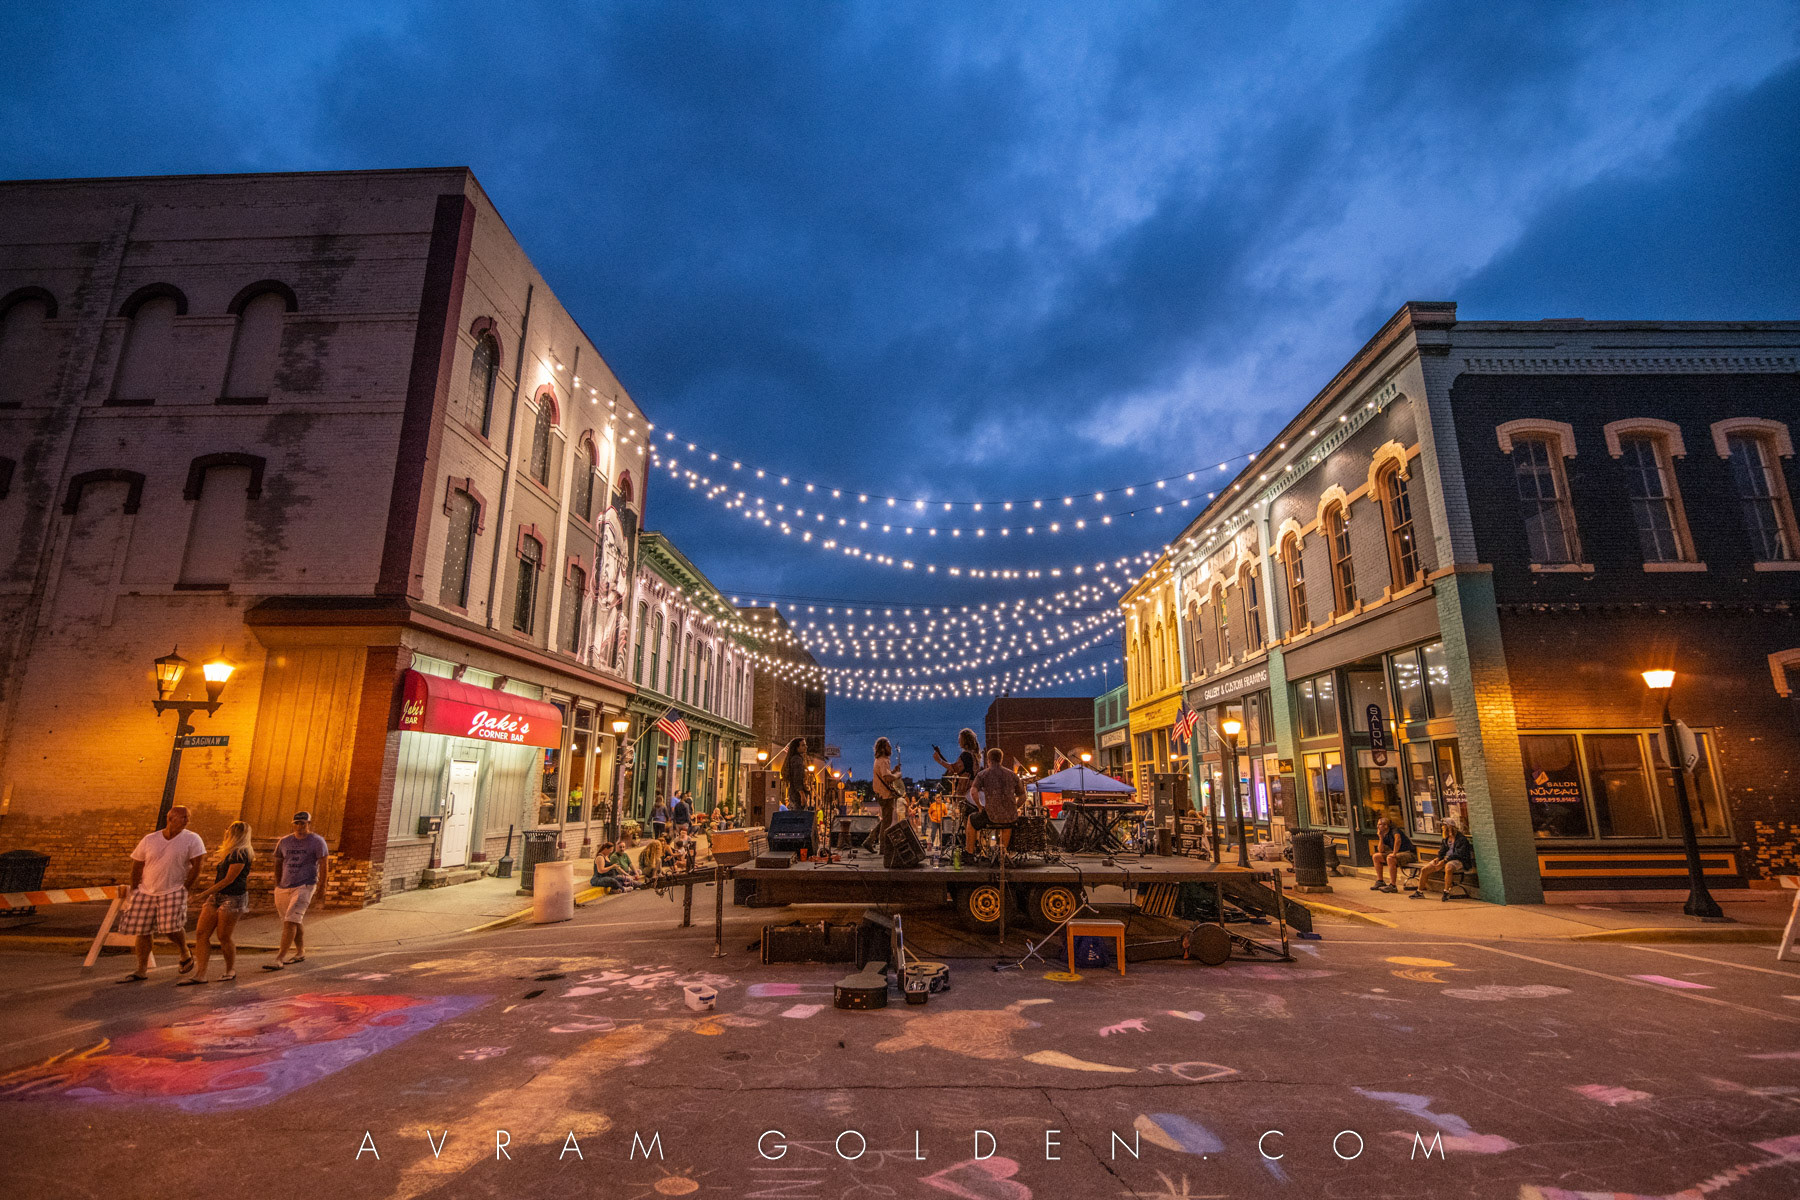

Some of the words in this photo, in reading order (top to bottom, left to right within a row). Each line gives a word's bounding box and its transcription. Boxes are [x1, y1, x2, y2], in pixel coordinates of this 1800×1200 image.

[1204, 686, 1220, 700] GALLERY
[1225, 679, 1244, 693] CUSTOM
[1243, 669, 1267, 687] FRAMING
[401, 699, 424, 721] Jake's
[404, 716, 419, 725] BAR
[467, 711, 530, 735] Jake's
[1369, 706, 1383, 747] SALON
[191, 736, 222, 746] SAGINAW
[478, 729, 508, 741] CORNER
[510, 733, 524, 743] BAR
